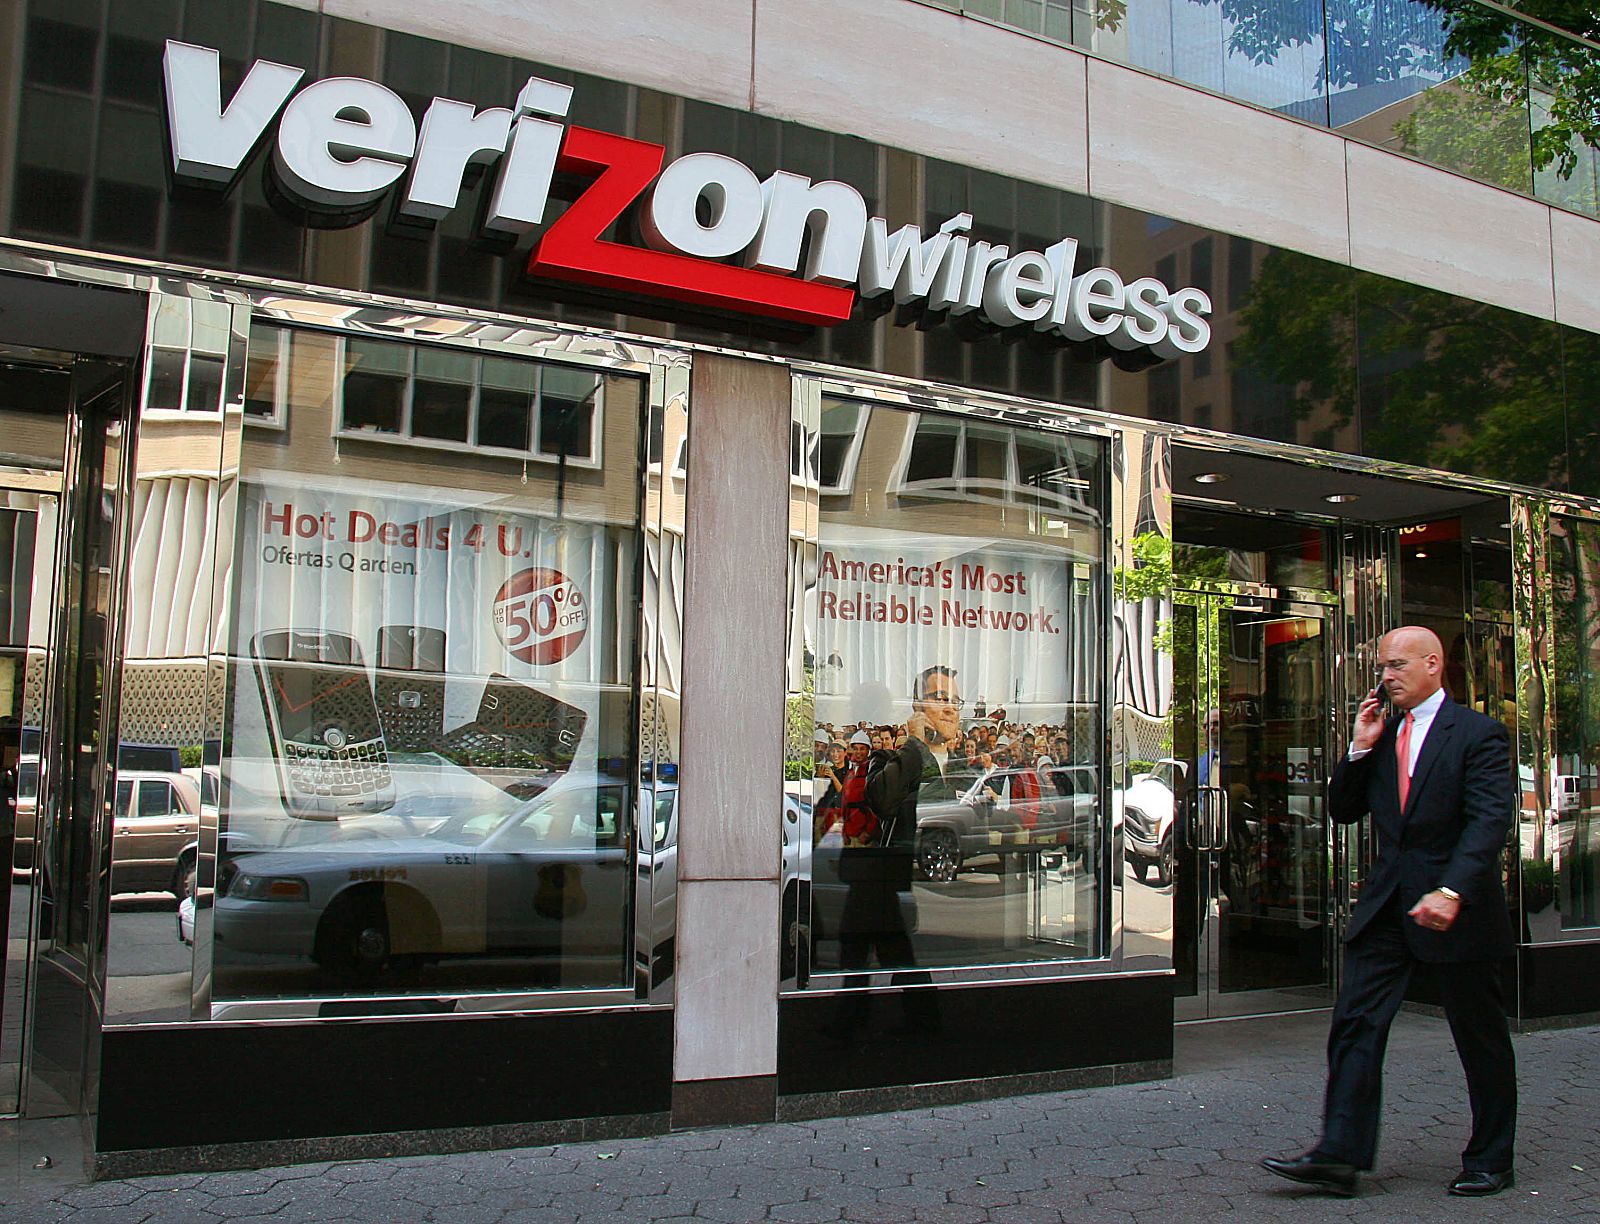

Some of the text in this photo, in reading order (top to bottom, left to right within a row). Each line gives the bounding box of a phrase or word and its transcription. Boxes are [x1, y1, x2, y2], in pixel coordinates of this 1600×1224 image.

[163, 39, 1213, 356] verizon wireless
[264, 502, 533, 559] Hot Deals 4 U.
[263, 545, 419, 576] Ofertas Q arden.
[818, 551, 1027, 596] America's Most
[493, 607, 504, 616] up
[496, 616, 504, 624] to
[505, 583, 582, 646] 50%
[559, 609, 585, 627] OFF!
[819, 591, 1060, 634] Reliable Network.
